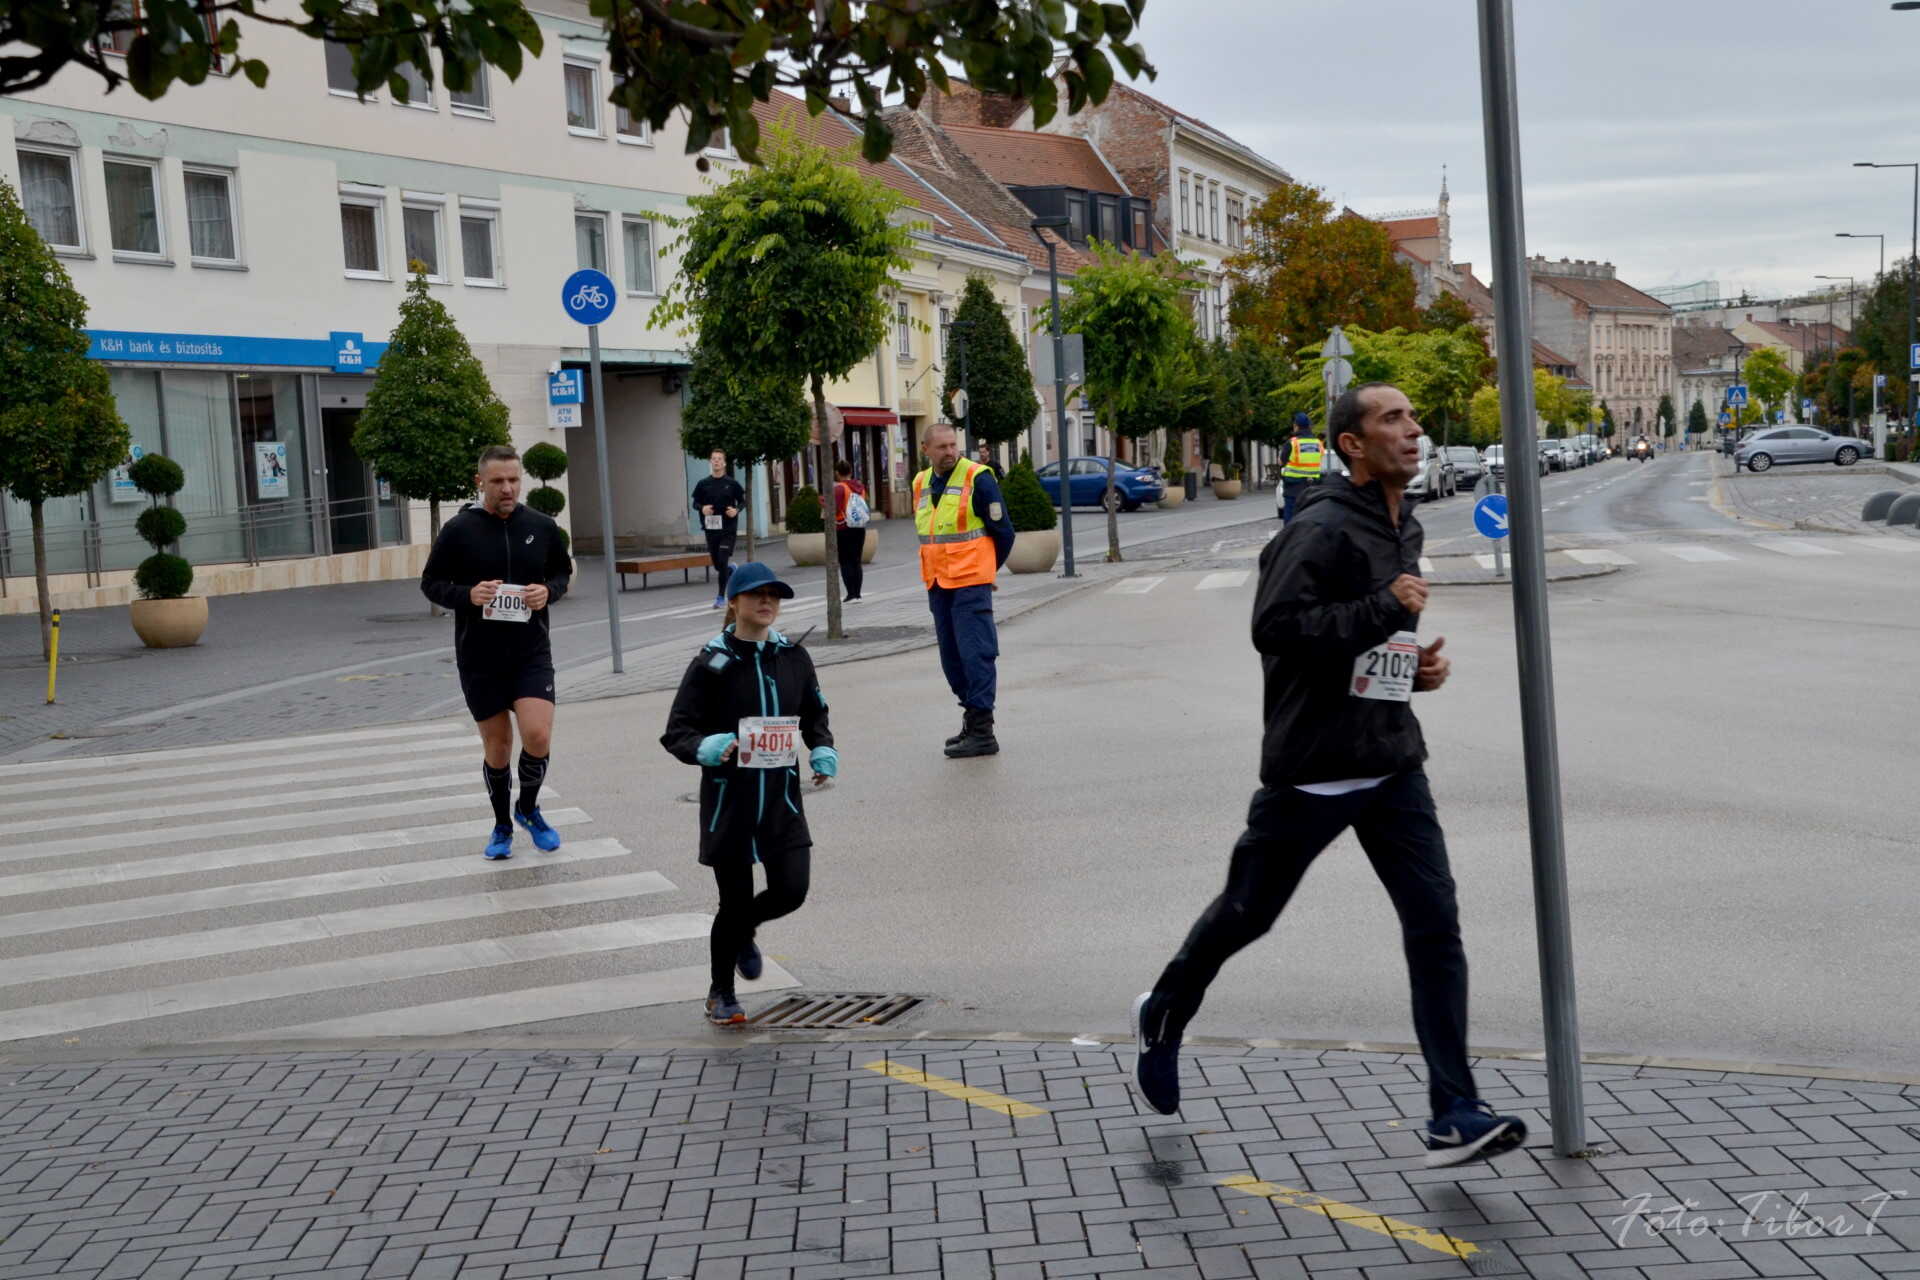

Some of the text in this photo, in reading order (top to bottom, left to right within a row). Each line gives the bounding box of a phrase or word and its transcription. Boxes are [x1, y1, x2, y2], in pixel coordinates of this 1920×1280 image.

[100, 338, 223, 356] K&H bank és biztosítás
[338, 355, 362, 365] K&H
[551, 386, 576, 397] K&H
[747, 732, 794, 752] 14014
